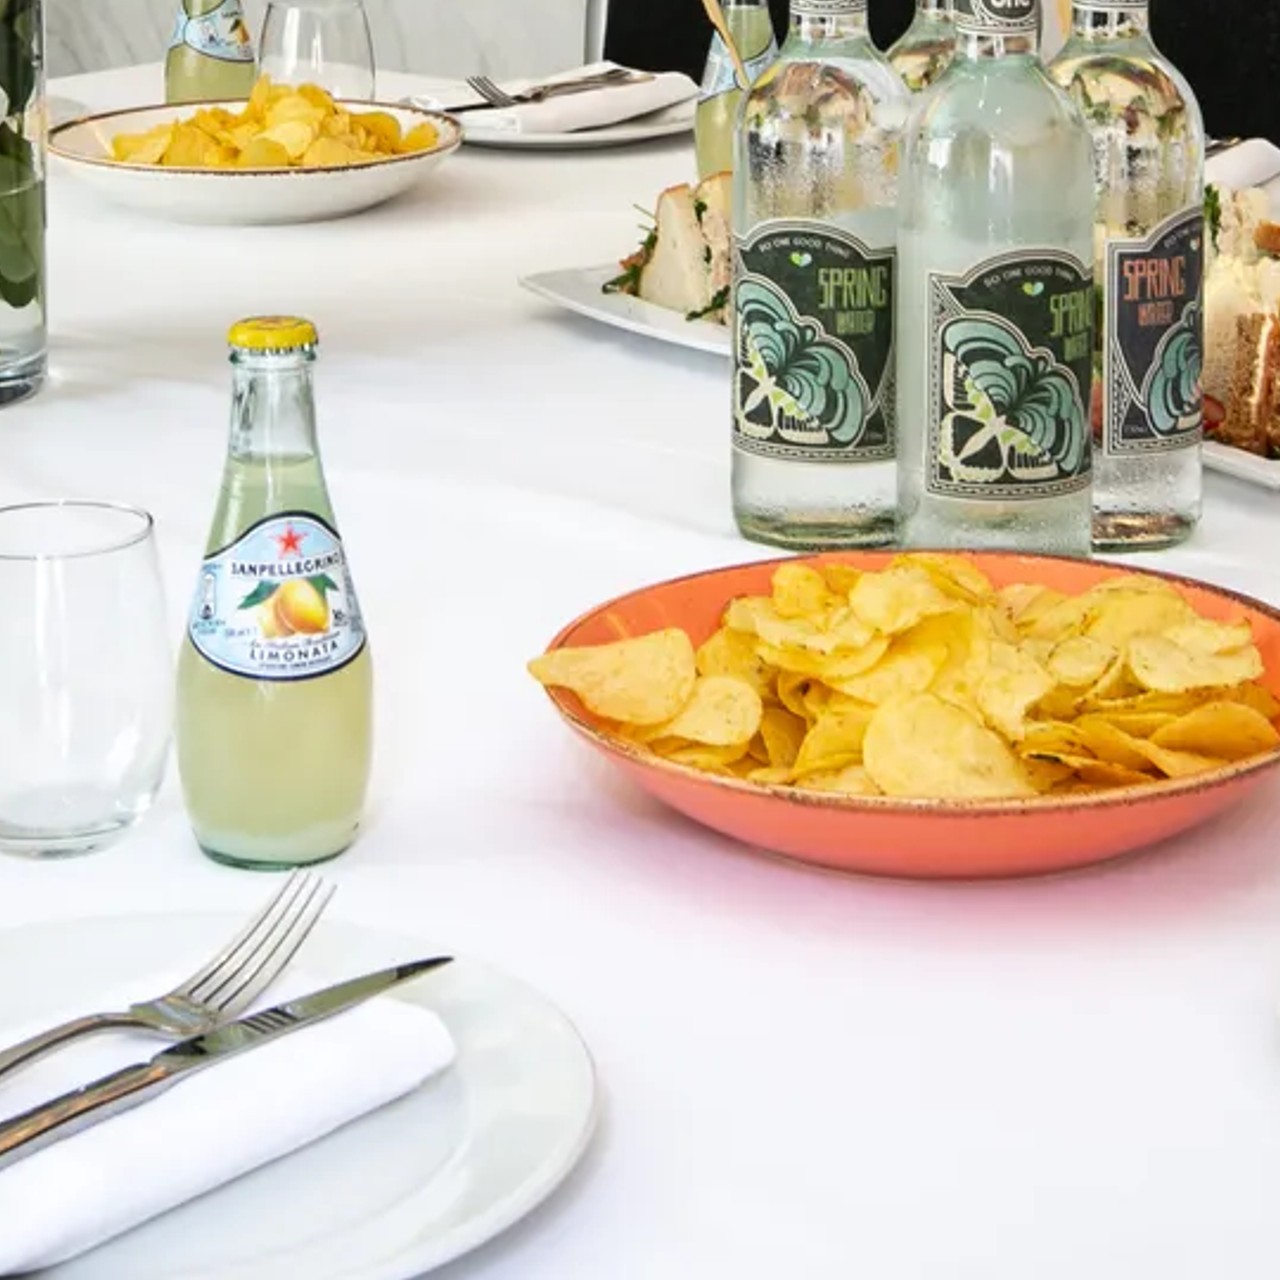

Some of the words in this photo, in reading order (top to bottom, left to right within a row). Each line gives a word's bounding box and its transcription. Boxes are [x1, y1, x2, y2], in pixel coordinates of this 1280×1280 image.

[818, 265, 888, 310] SPRING
[1123, 256, 1186, 301] SPRING
[250, 639, 338, 663] LIMONATA
